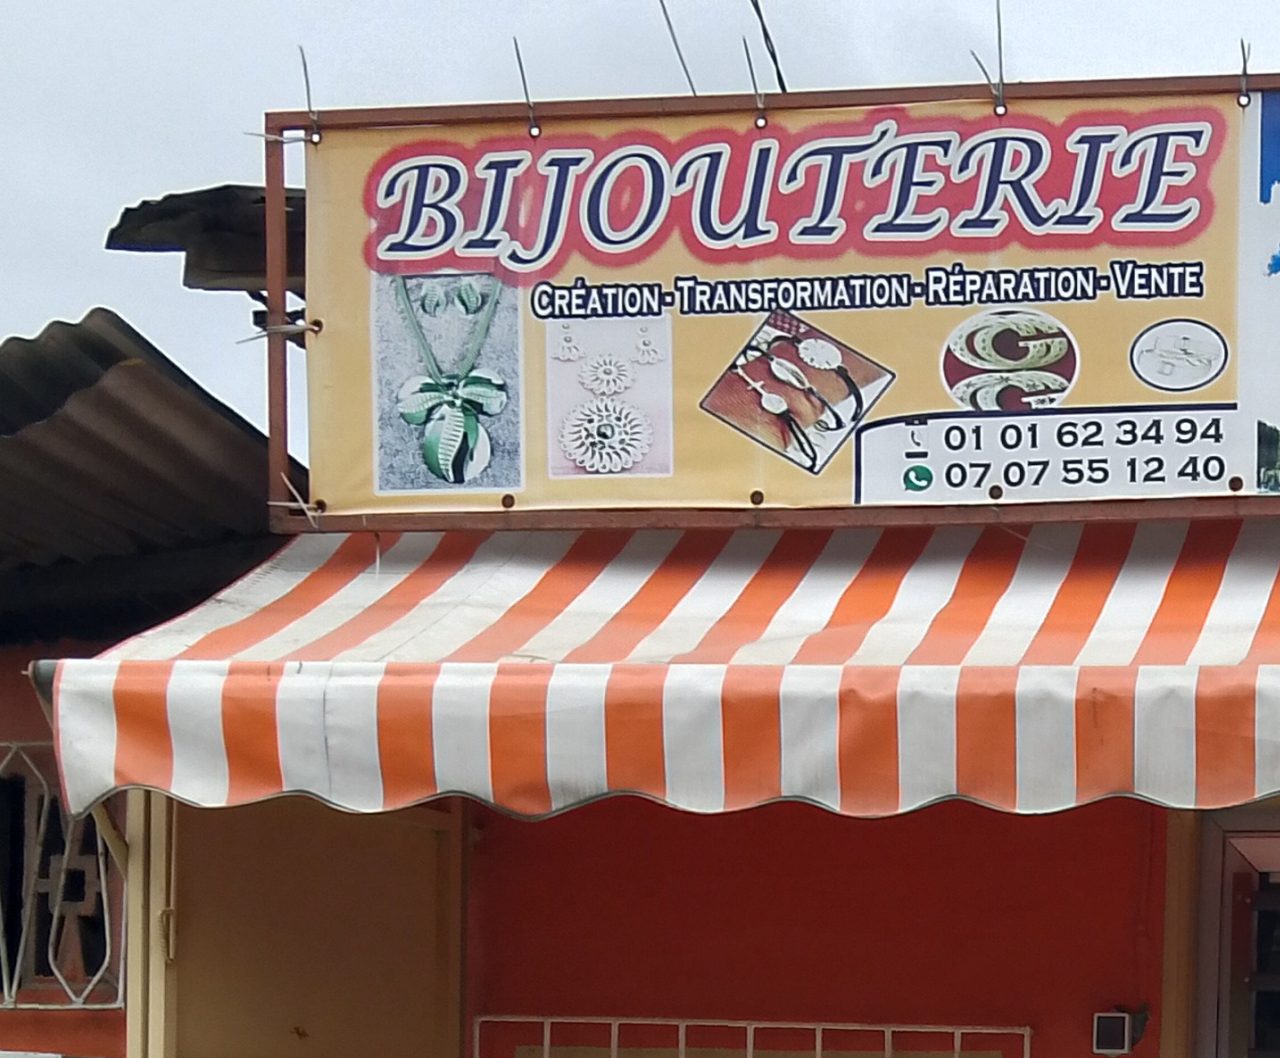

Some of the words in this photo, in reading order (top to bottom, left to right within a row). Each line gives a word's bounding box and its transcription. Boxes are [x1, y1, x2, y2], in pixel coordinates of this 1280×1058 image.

[378, 119, 1212, 273] BIJOUTERIE
[944, 425, 982, 451] 01
[1000, 422, 1039, 450] 01
[1056, 420, 1104, 448] 62
[1115, 418, 1164, 446] 34
[1175, 417, 1224, 444] 94
[945, 462, 992, 488] 07
[1003, 459, 1050, 487] 07
[1061, 458, 1110, 484] 55
[1126, 456, 1166, 483] 12
[1177, 455, 1226, 481] 40
